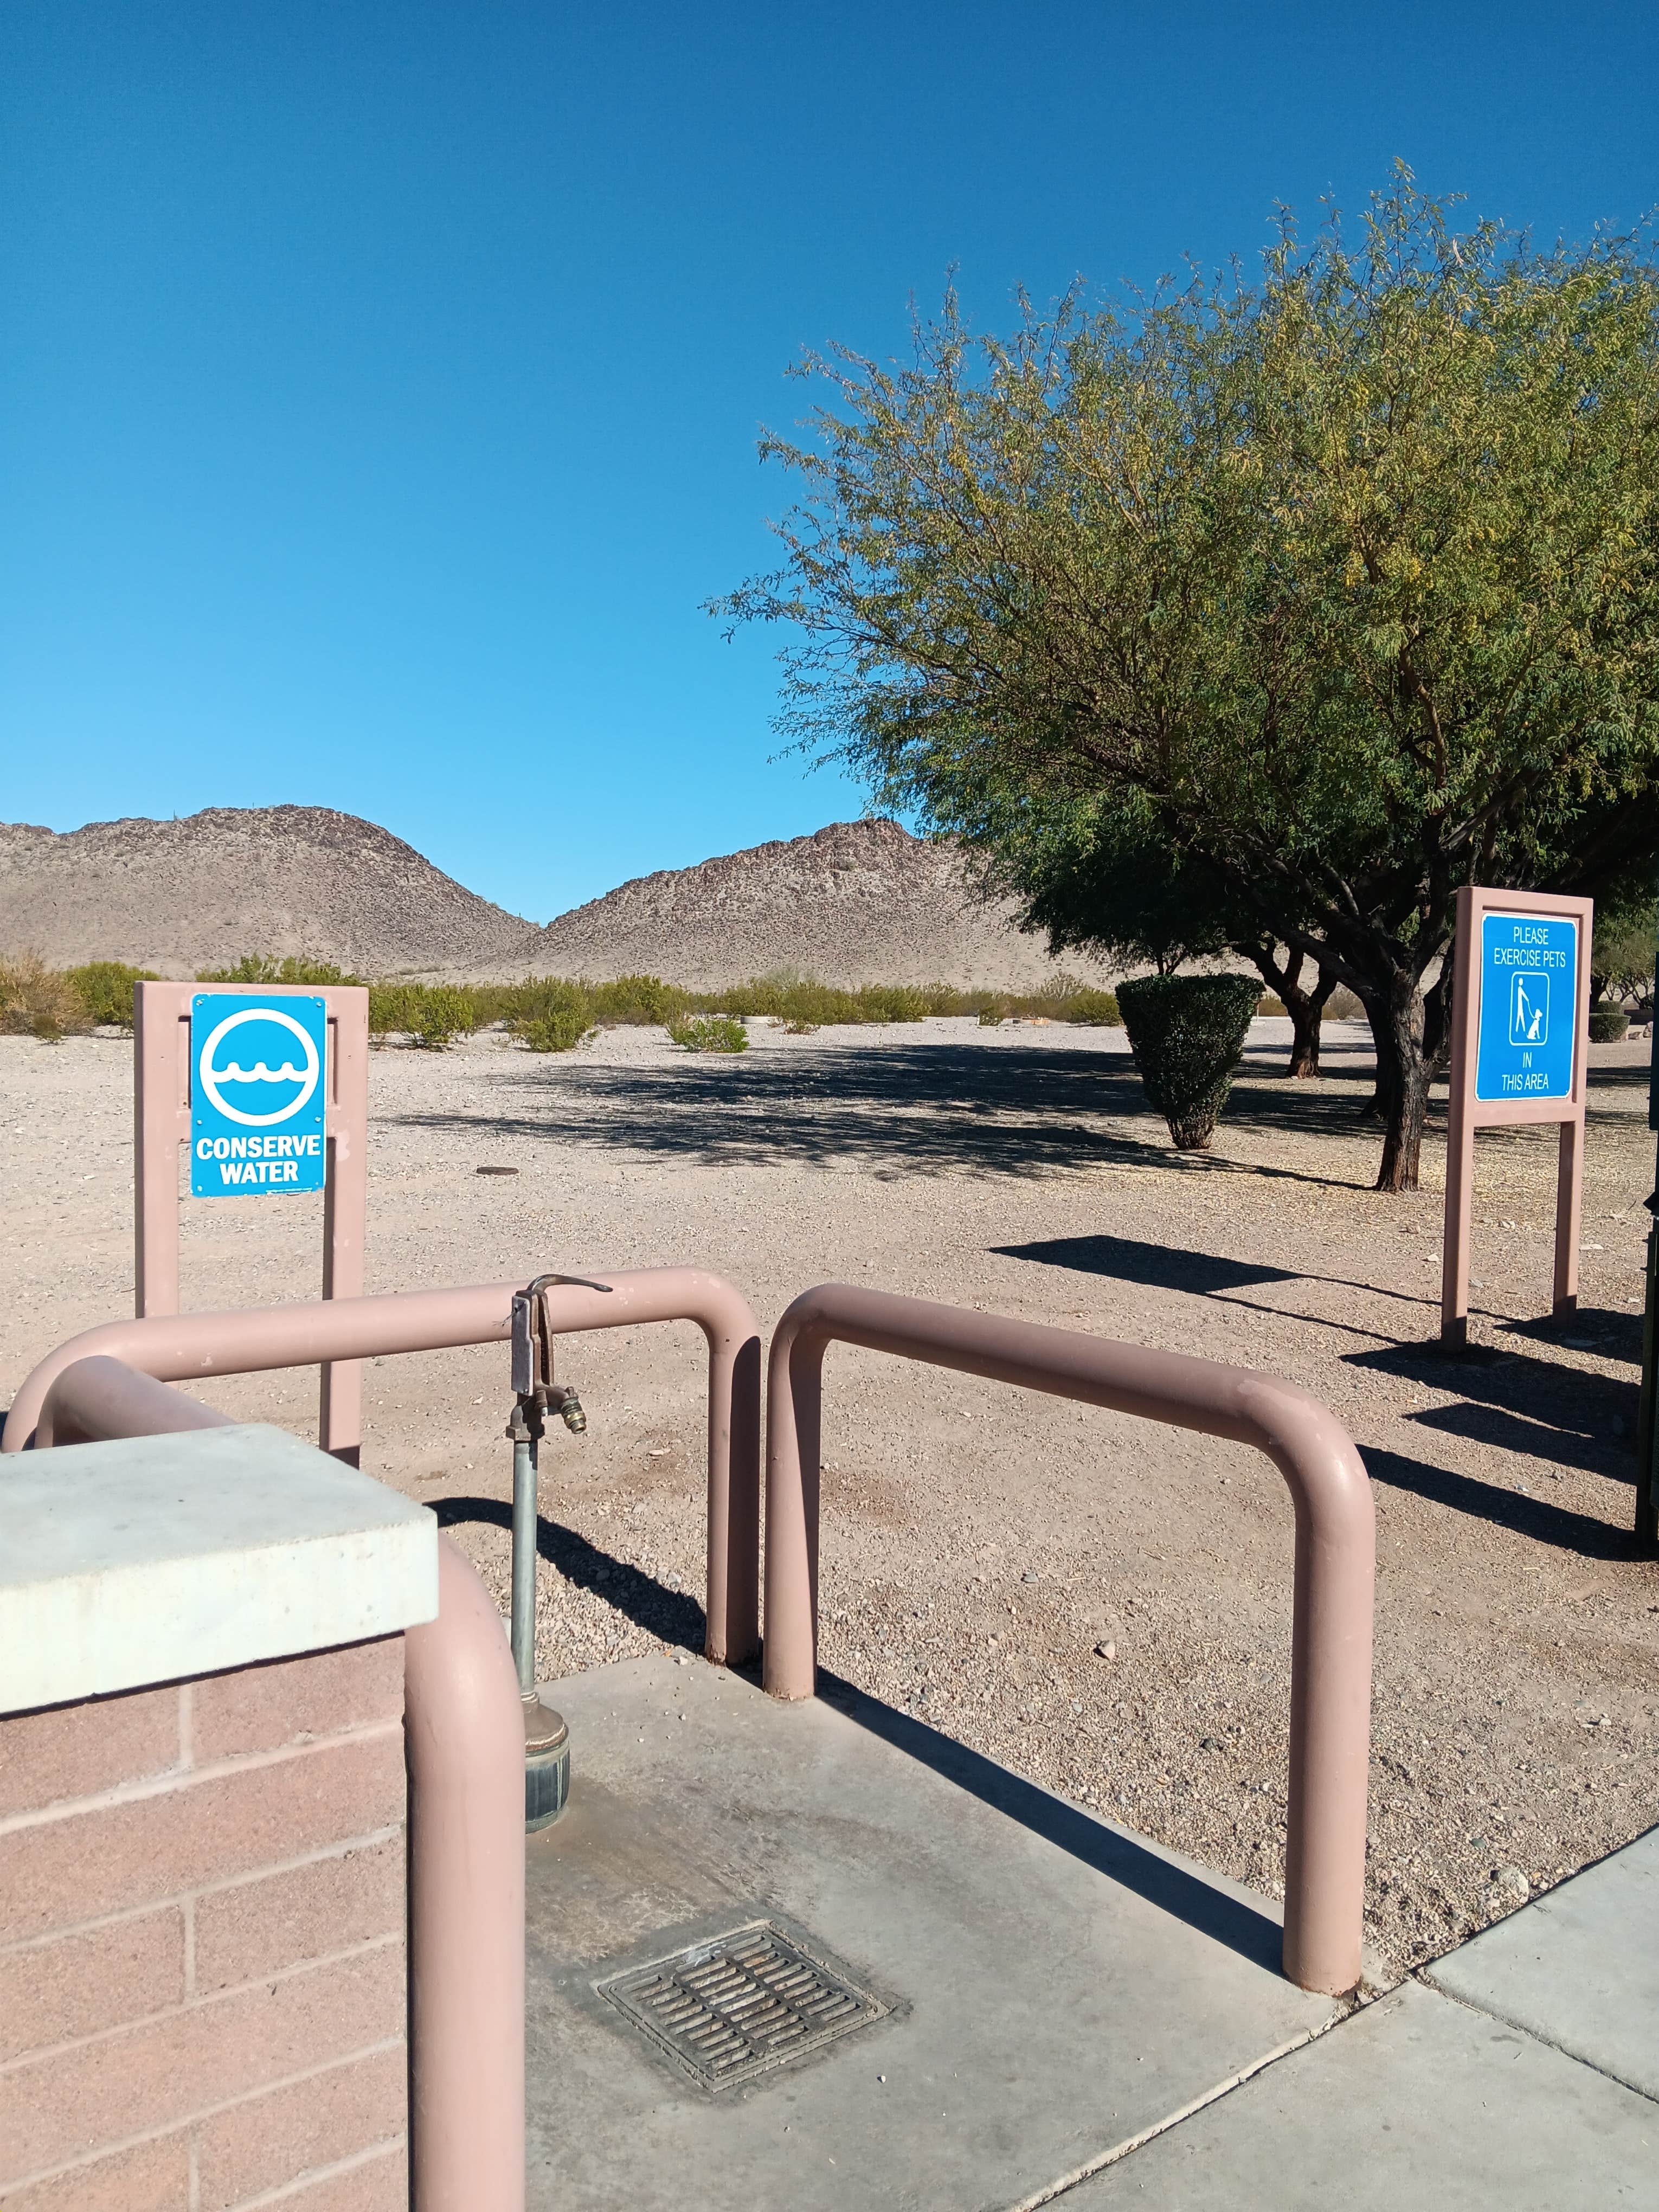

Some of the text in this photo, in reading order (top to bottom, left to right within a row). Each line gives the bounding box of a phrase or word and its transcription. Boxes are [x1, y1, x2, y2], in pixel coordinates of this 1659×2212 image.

[1513, 926, 1549, 945] PLEASE
[1494, 947, 1566, 968] EXERCISE PETS
[1522, 1052, 1532, 1069] IN
[1501, 1073, 1549, 1091] THIS AREA
[196, 1134, 321, 1160] CONSERVE
[220, 1160, 299, 1185] WATER
